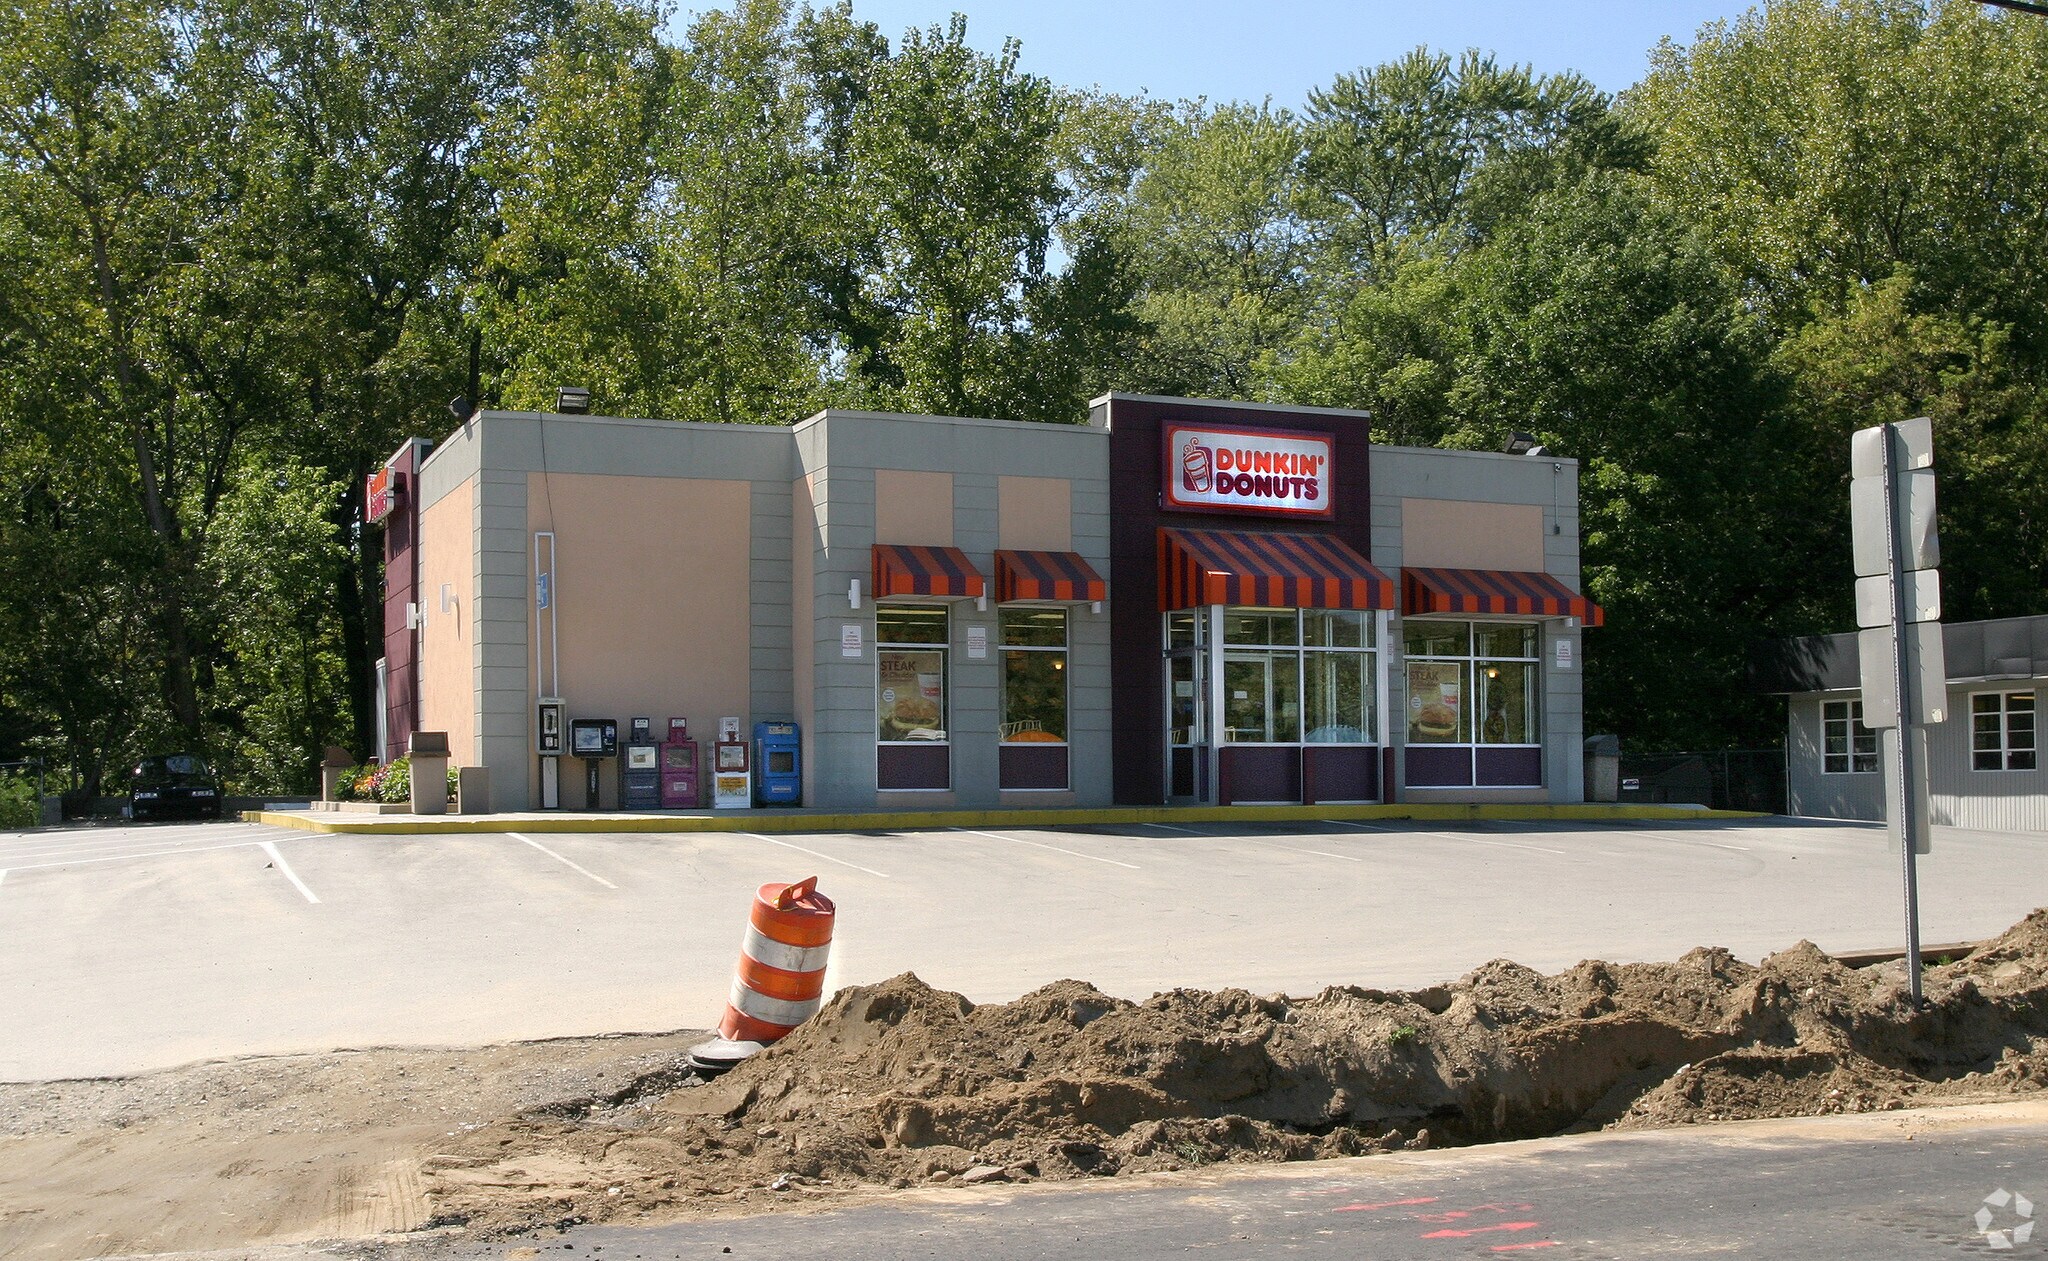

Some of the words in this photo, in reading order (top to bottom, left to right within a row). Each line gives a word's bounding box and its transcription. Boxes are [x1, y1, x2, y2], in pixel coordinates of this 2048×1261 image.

[1216, 448, 1324, 476] DUNKIN'
[1216, 472, 1319, 500] DONUTS
[880, 661, 916, 671] STEAK
